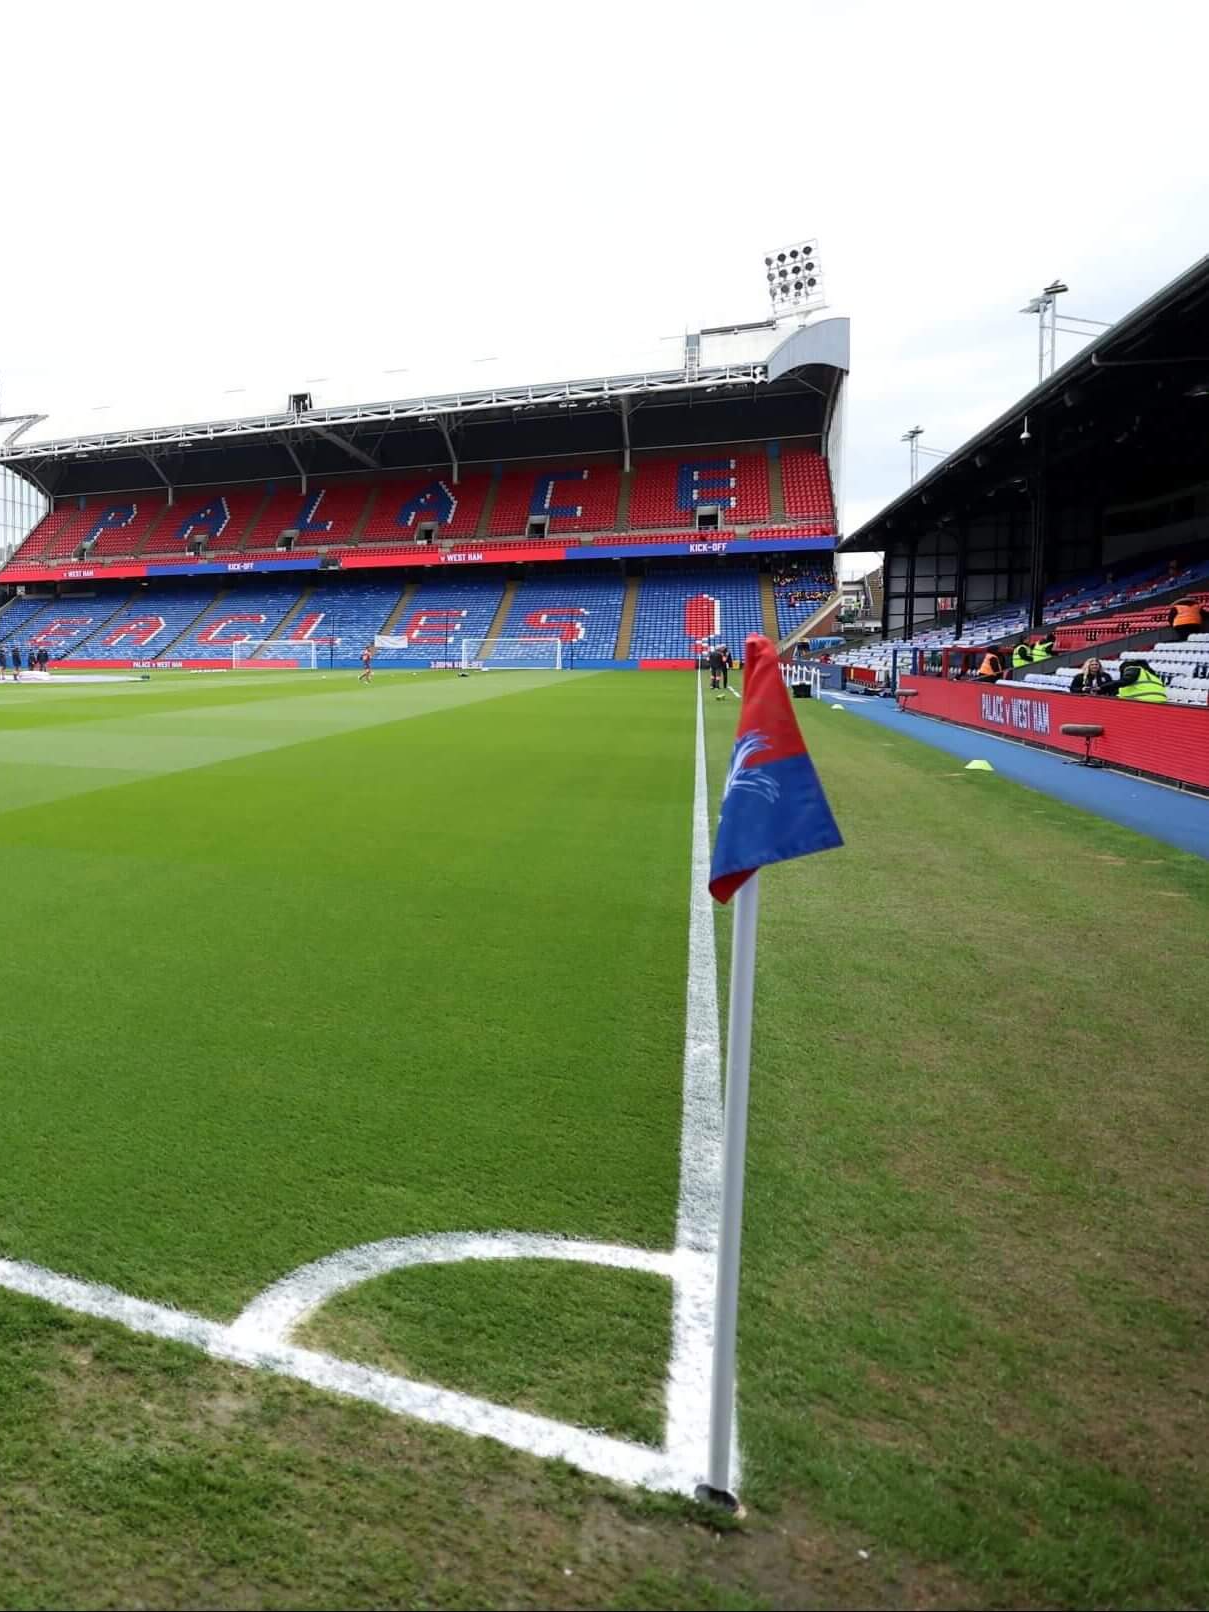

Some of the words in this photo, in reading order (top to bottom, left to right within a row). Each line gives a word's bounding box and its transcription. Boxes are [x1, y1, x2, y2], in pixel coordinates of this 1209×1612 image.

[84, 459, 737, 544] PALACE
[446, 553, 467, 562] WEST
[467, 551, 483, 561] HAM
[689, 542, 728, 553] KICK-OFF
[981, 692, 1005, 724] PALACE
[1011, 696, 1031, 729] WEST
[1031, 700, 1051, 736] HAM
